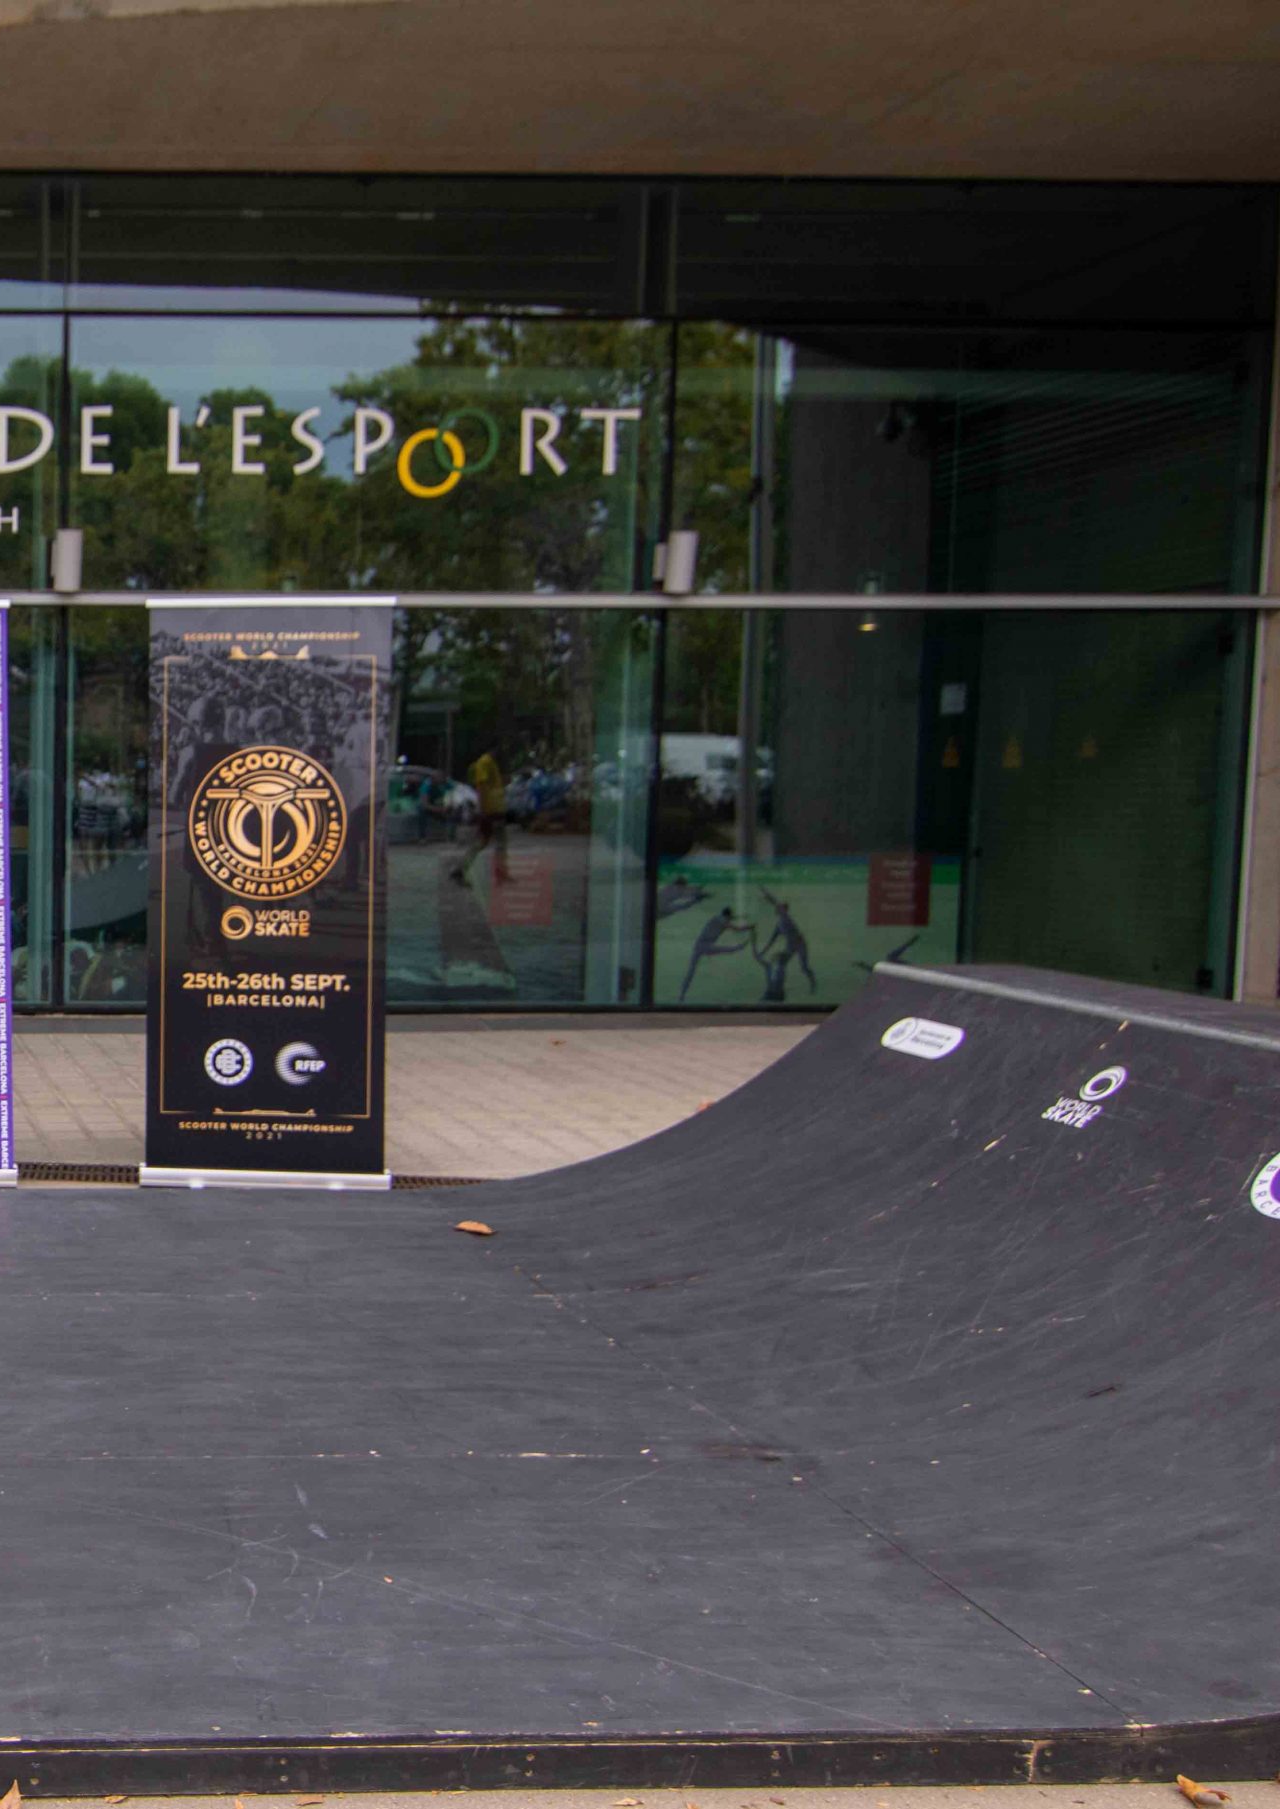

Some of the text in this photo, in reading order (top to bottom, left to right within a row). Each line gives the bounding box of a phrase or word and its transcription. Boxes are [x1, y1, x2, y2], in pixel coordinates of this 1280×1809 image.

[219, 752, 318, 784] SCOOTER
[195, 821, 341, 895] WORLD CHAMPIONSHIP
[255, 909, 311, 922] WORLD
[255, 922, 311, 937] SKATE
[182, 972, 351, 992] 25th-26th SEPT.
[0, 1043, 7, 1093] BARCELONA
[1041, 1106, 1092, 1128] SKATE
[1055, 1097, 1103, 1117] WORLD
[179, 1121, 354, 1133] SCOOTER WORLD CHAMPIONSHIP
[246, 1131, 283, 1140] 2021
